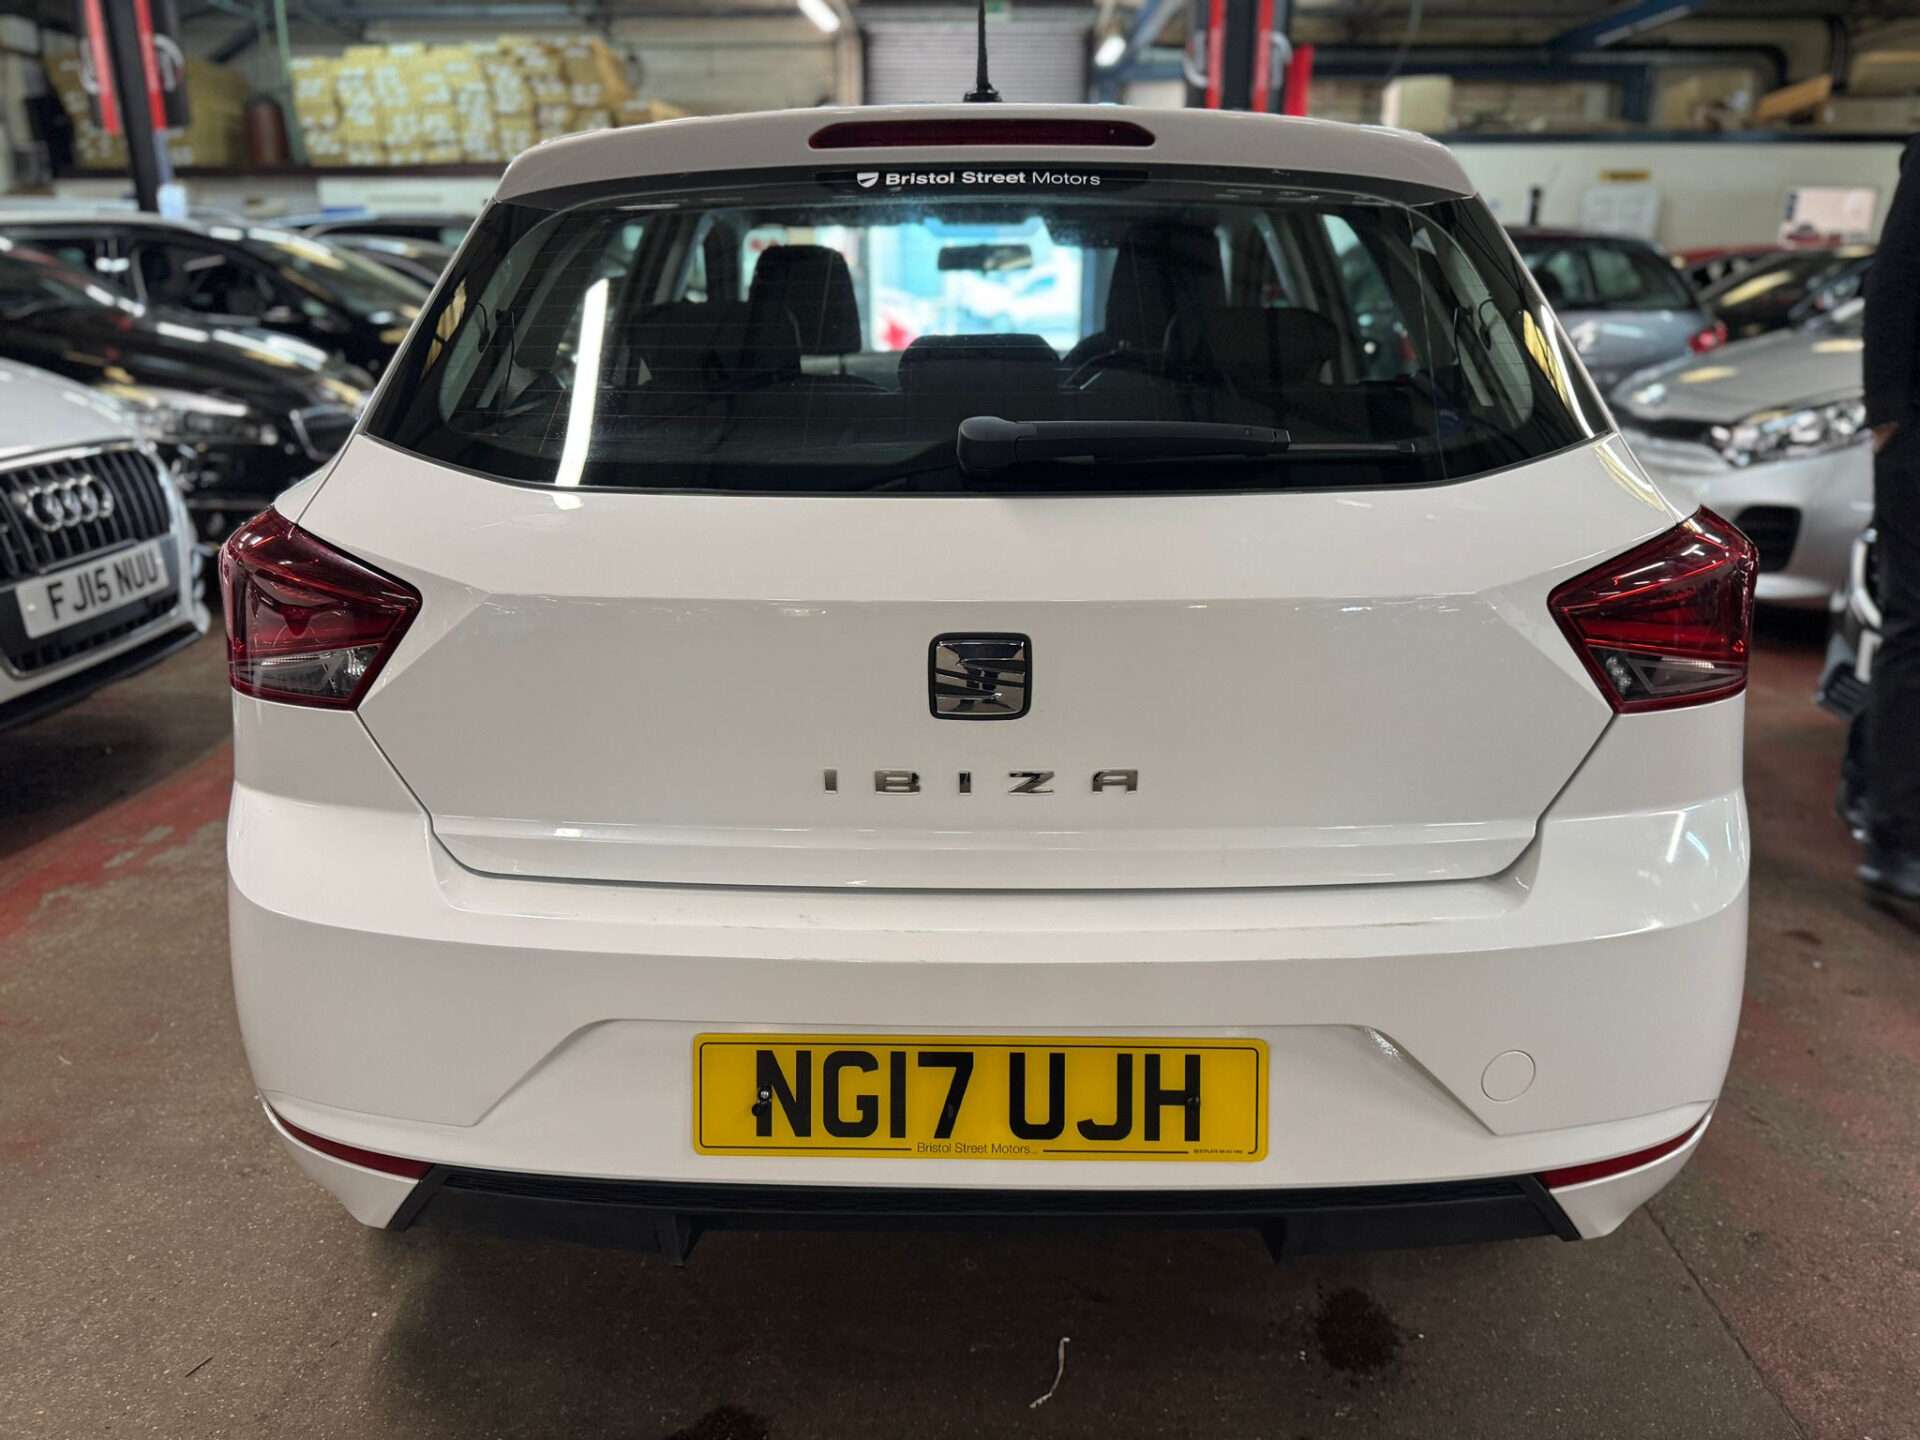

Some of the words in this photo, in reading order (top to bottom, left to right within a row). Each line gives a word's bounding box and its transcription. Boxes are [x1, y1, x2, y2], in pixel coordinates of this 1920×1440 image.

[885, 172, 955, 185] Bristol
[961, 171, 1027, 184] Street
[1032, 171, 1101, 186] Motors
[46, 565, 112, 620] FJ15
[113, 550, 158, 596] NUU
[823, 769, 1139, 794] IBIZA
[755, 1049, 975, 1139] NG17
[1008, 1051, 1201, 1142] UJH
[917, 1142, 952, 1153] Bristol
[955, 1143, 988, 1154] Street
